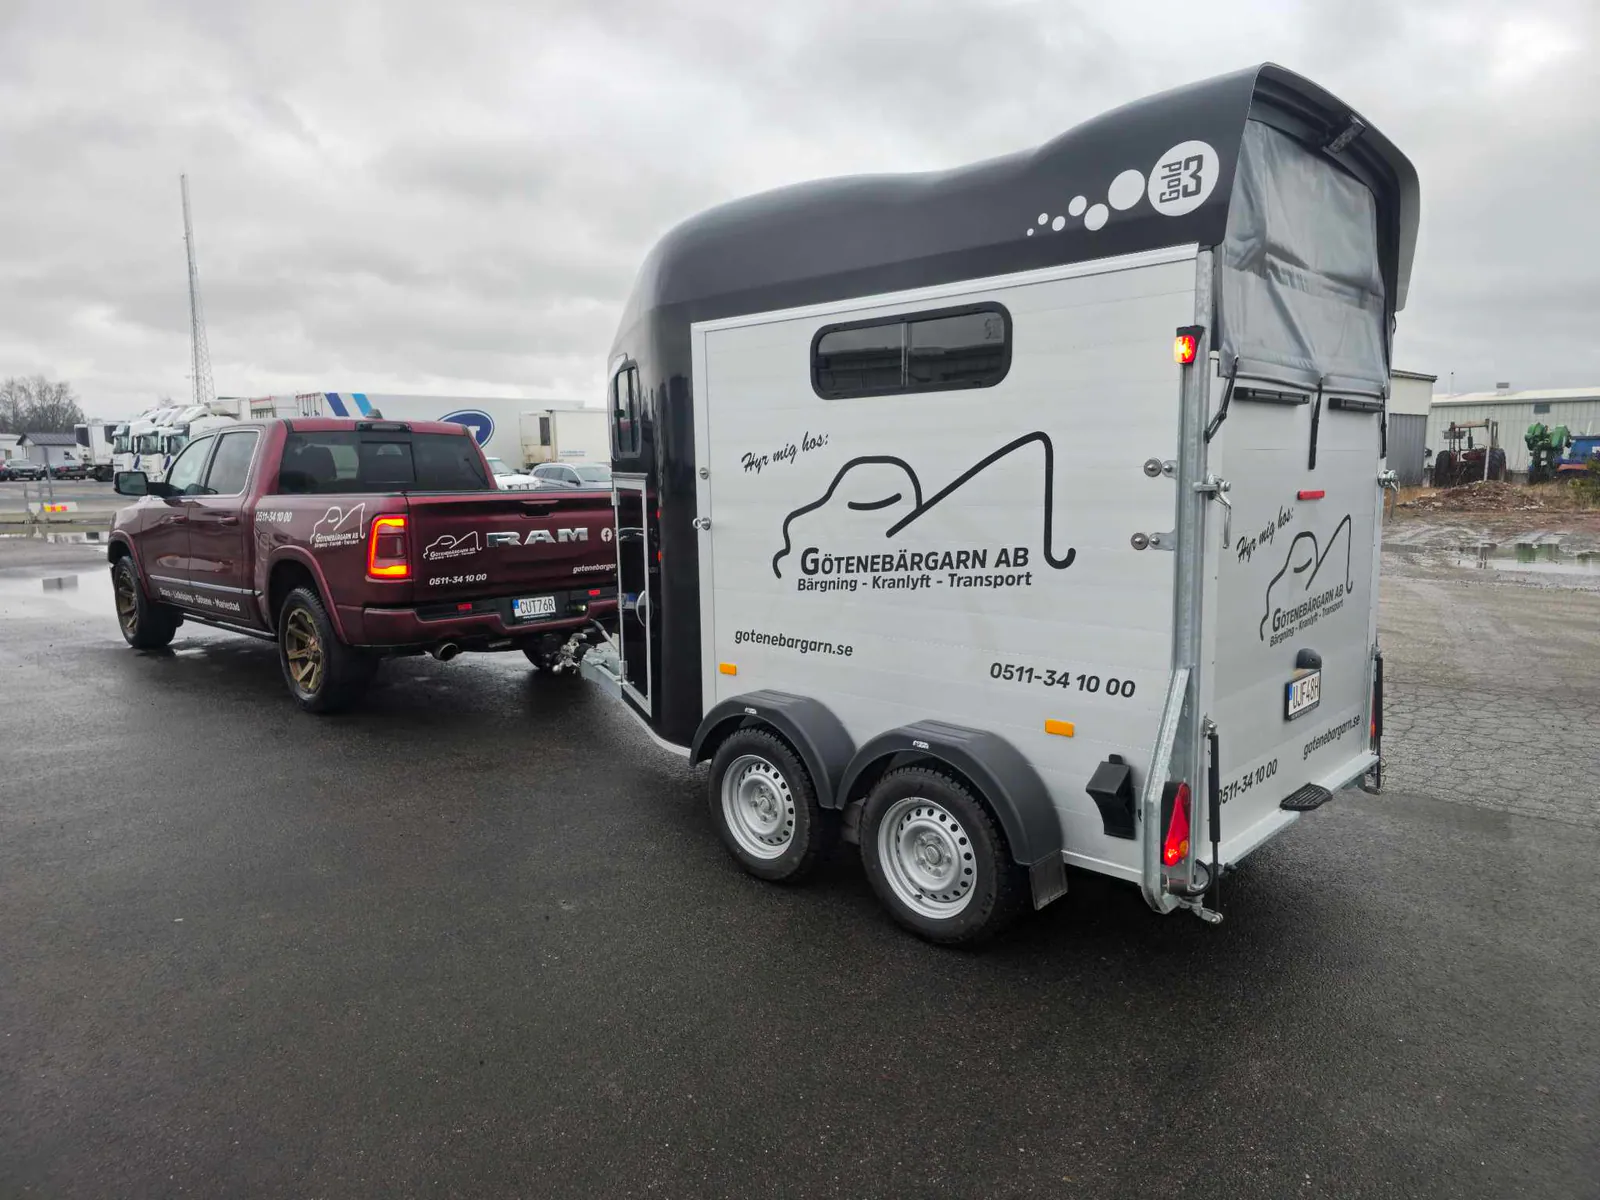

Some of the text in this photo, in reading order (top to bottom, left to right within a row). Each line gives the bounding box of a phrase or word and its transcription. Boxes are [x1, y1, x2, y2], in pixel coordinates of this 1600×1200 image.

[1159, 160, 1182, 203] Gold
[1182, 154, 1203, 198] 3
[741, 431, 828, 474] Hyr mig hos:
[486, 527, 589, 548] RAM
[1236, 536, 1257, 564] Hyr
[1259, 521, 1275, 545] mig
[429, 573, 487, 586] 0511-34 10 00
[801, 547, 1029, 576] GÖTENEBÄRGARN AB
[797, 578, 858, 592] Bärgning
[872, 574, 931, 590] Kranlyft
[948, 571, 1032, 588] Transport
[1270, 626, 1295, 647] Bärgning
[1299, 610, 1318, 631] Kranlyft
[1322, 599, 1344, 618] Transport
[1273, 584, 1344, 632] GÖTENEBÄRGARN AB
[735, 629, 853, 656] gotenebargarn.se
[990, 662, 1136, 698] 0511-34 10 00
[1303, 714, 1360, 760] gotenebargarn.se
[1255, 765, 1265, 784] 10
[1266, 758, 1278, 779] 00
